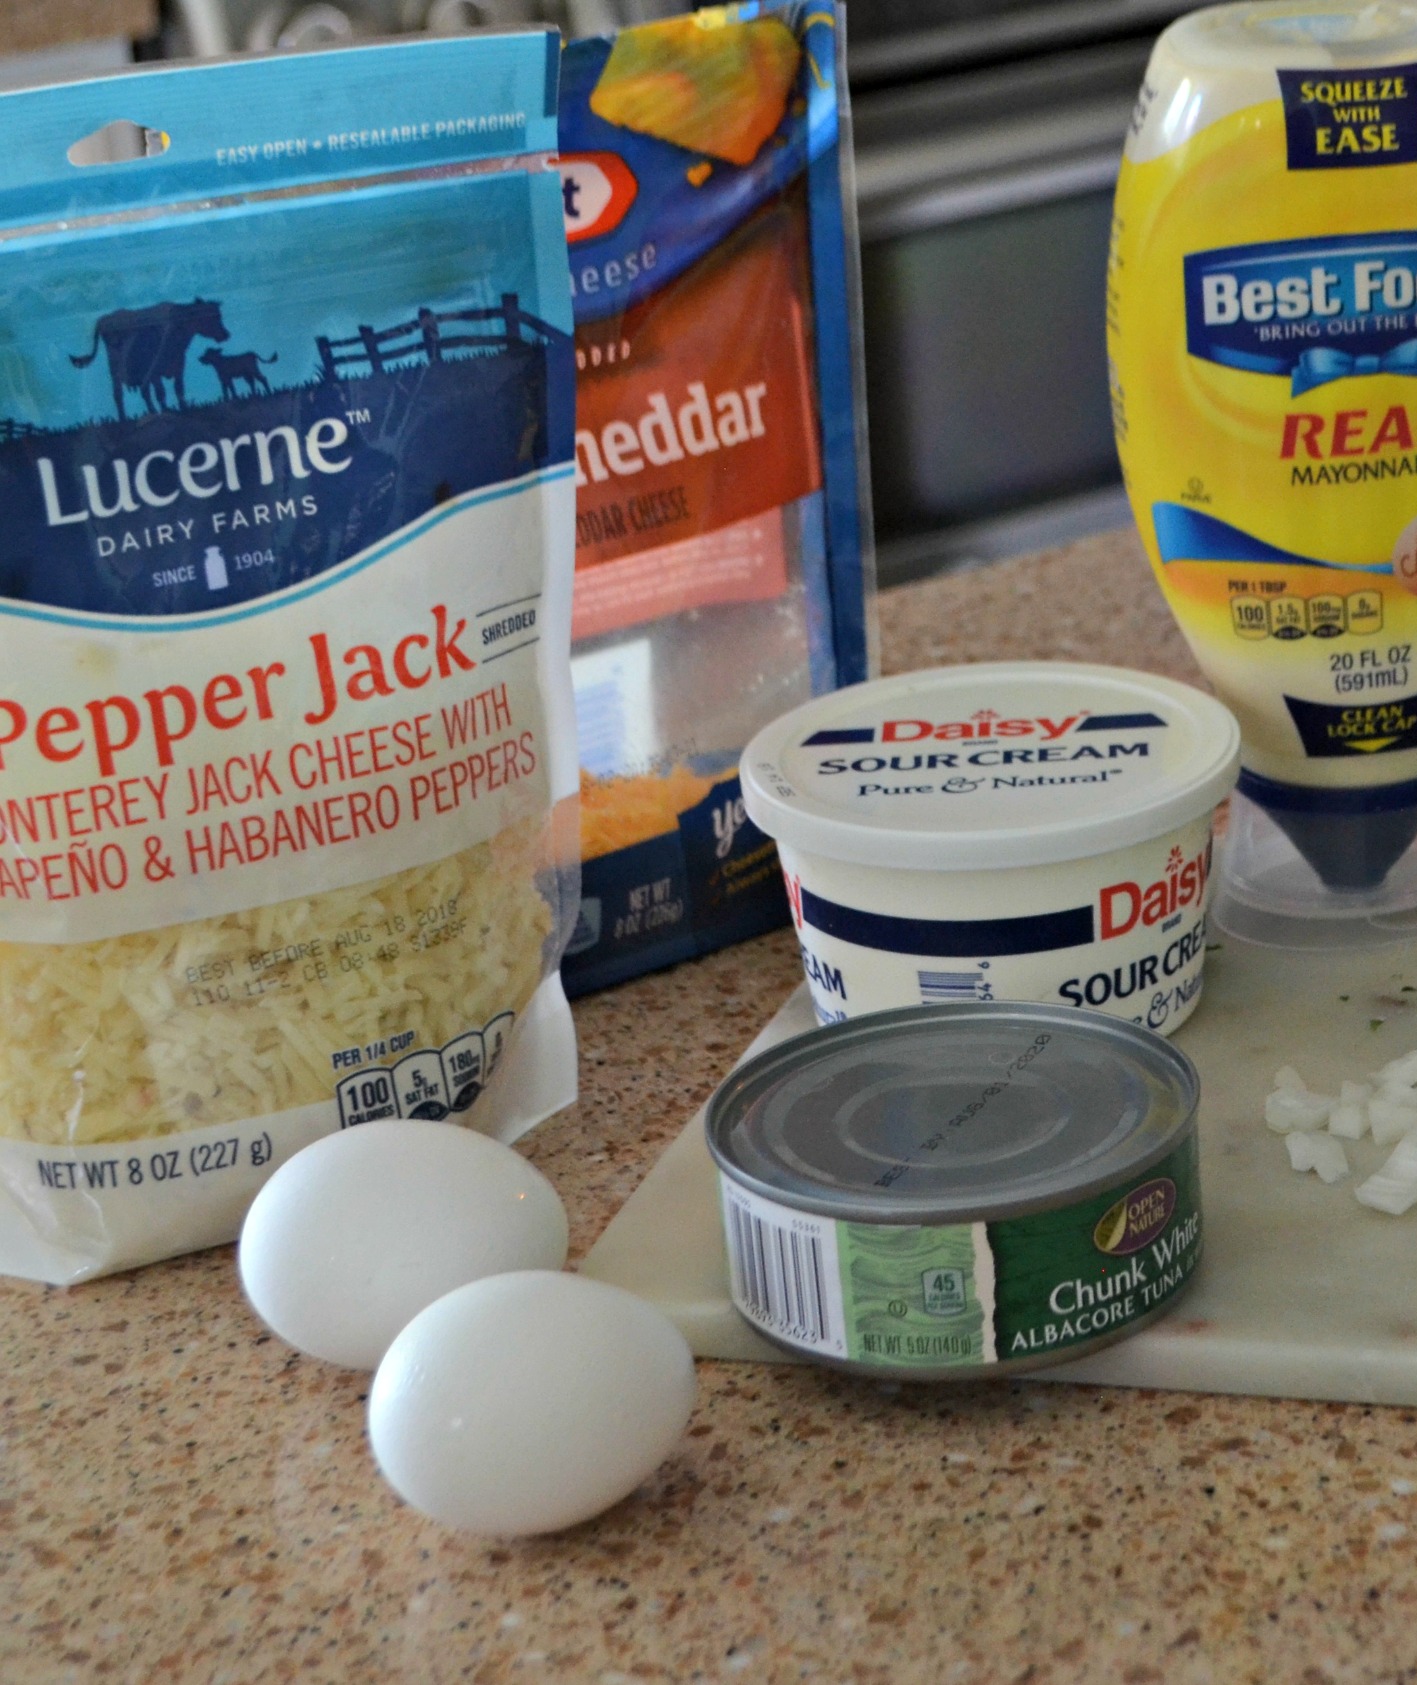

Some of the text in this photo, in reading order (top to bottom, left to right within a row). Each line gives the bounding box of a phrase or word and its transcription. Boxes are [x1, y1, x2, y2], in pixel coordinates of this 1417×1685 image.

[1301, 77, 1408, 108] SQUEEZE
[1333, 105, 1381, 124] WITH
[216, 111, 526, 167] EASY OPEN RESEALABLE PACKAGING
[1316, 123, 1400, 155] EASE
[1202, 265, 1343, 326] Best
[1327, 318, 1367, 335] OUT
[1374, 313, 1409, 330] THE
[37, 417, 353, 527] Lucerne
[97, 495, 319, 558] DAIRY FARMS
[152, 548, 276, 588] SINCE 1904
[1228, 579, 1248, 593] PER
[482, 609, 537, 647] SHREDDED
[1237, 604, 1264, 622] 100
[304, 603, 478, 726] Jack
[1329, 644, 1412, 672] 20 FL OZ
[1334, 665, 1409, 694] (591mL)
[880, 711, 1080, 742] Daisy
[1327, 714, 1417, 738] LOCK CAP
[1342, 704, 1404, 722] CLEAN
[0, 681, 513, 846] NTEREY JACK CHEESE WITH
[818, 742, 1150, 776] SOUR CREAM
[856, 783, 935, 797] Pure
[940, 775, 987, 795] &
[143, 835, 176, 883] &
[185, 784, 401, 876] HABANERO
[408, 730, 536, 822] PEPPERS
[185, 957, 237, 984] BEST
[248, 937, 325, 973] BEFORE
[334, 923, 373, 951] AUG
[1058, 954, 1159, 1008] SOUR
[1146, 986, 1174, 1030] &
[332, 1030, 416, 1070] PER 1/4 CUP
[346, 1076, 391, 1112] 100
[423, 1082, 440, 1099] FAT
[36, 1131, 274, 1190] NET WT 8 OZ (227 g)
[1128, 1185, 1166, 1221] OPEN
[1128, 1203, 1166, 1238] NATURE
[1049, 1256, 1148, 1316] Chunk
[1152, 1211, 1199, 1270] White
[933, 1272, 956, 1292] 45
[1011, 1295, 1136, 1352] ALBACORE
[1141, 1262, 1184, 1307] TUNA
[863, 1333, 883, 1354] NET
[916, 1335, 931, 1355] OZ
